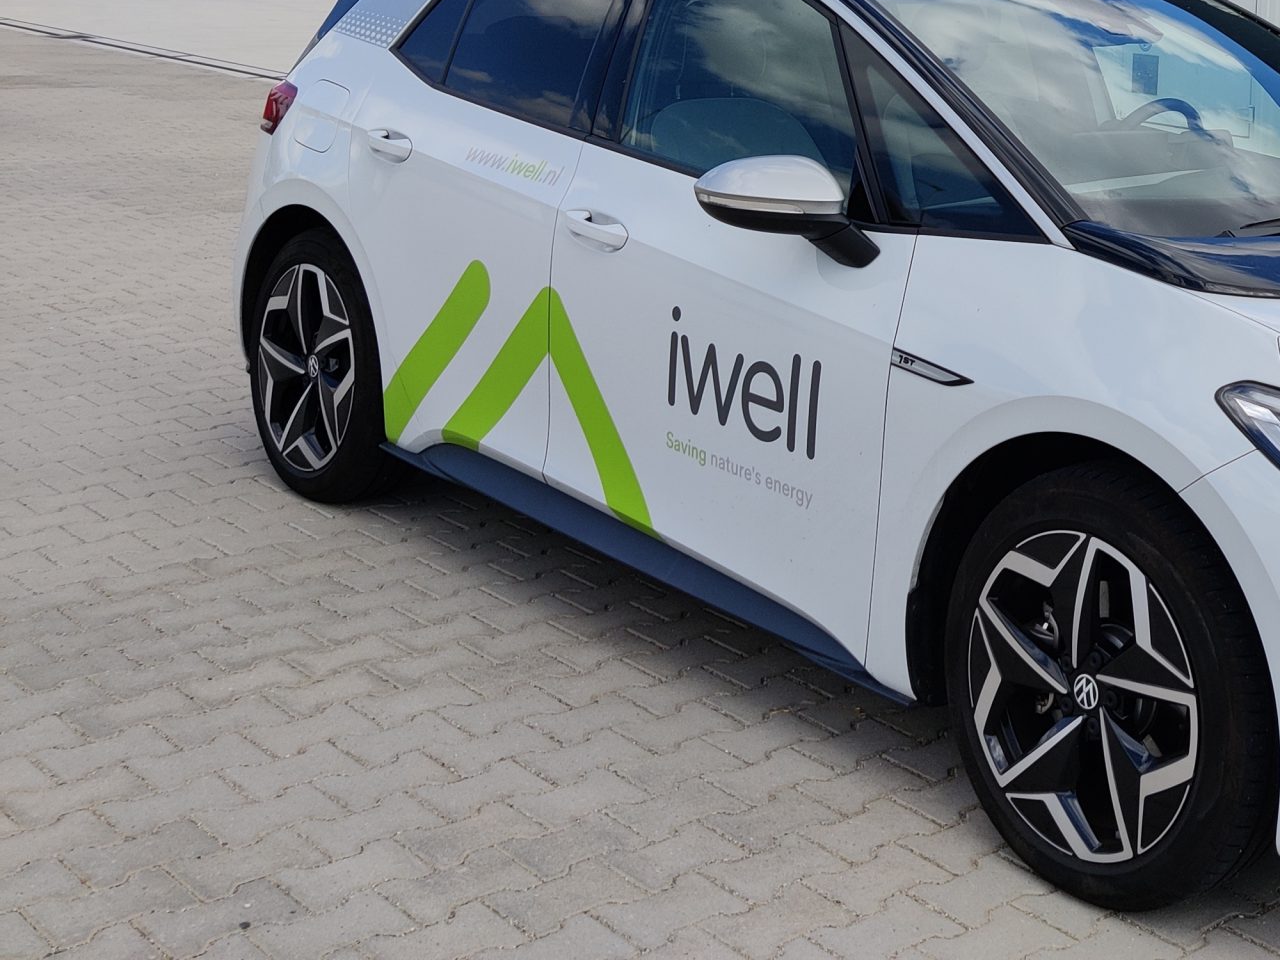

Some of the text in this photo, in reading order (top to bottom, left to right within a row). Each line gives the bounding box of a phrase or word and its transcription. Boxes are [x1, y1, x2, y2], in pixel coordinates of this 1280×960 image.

[464, 146, 566, 187] www.iwell.nl
[667, 305, 822, 460] iwell
[898, 354, 916, 366] 1ST
[665, 431, 813, 510] Saving nature's energy
